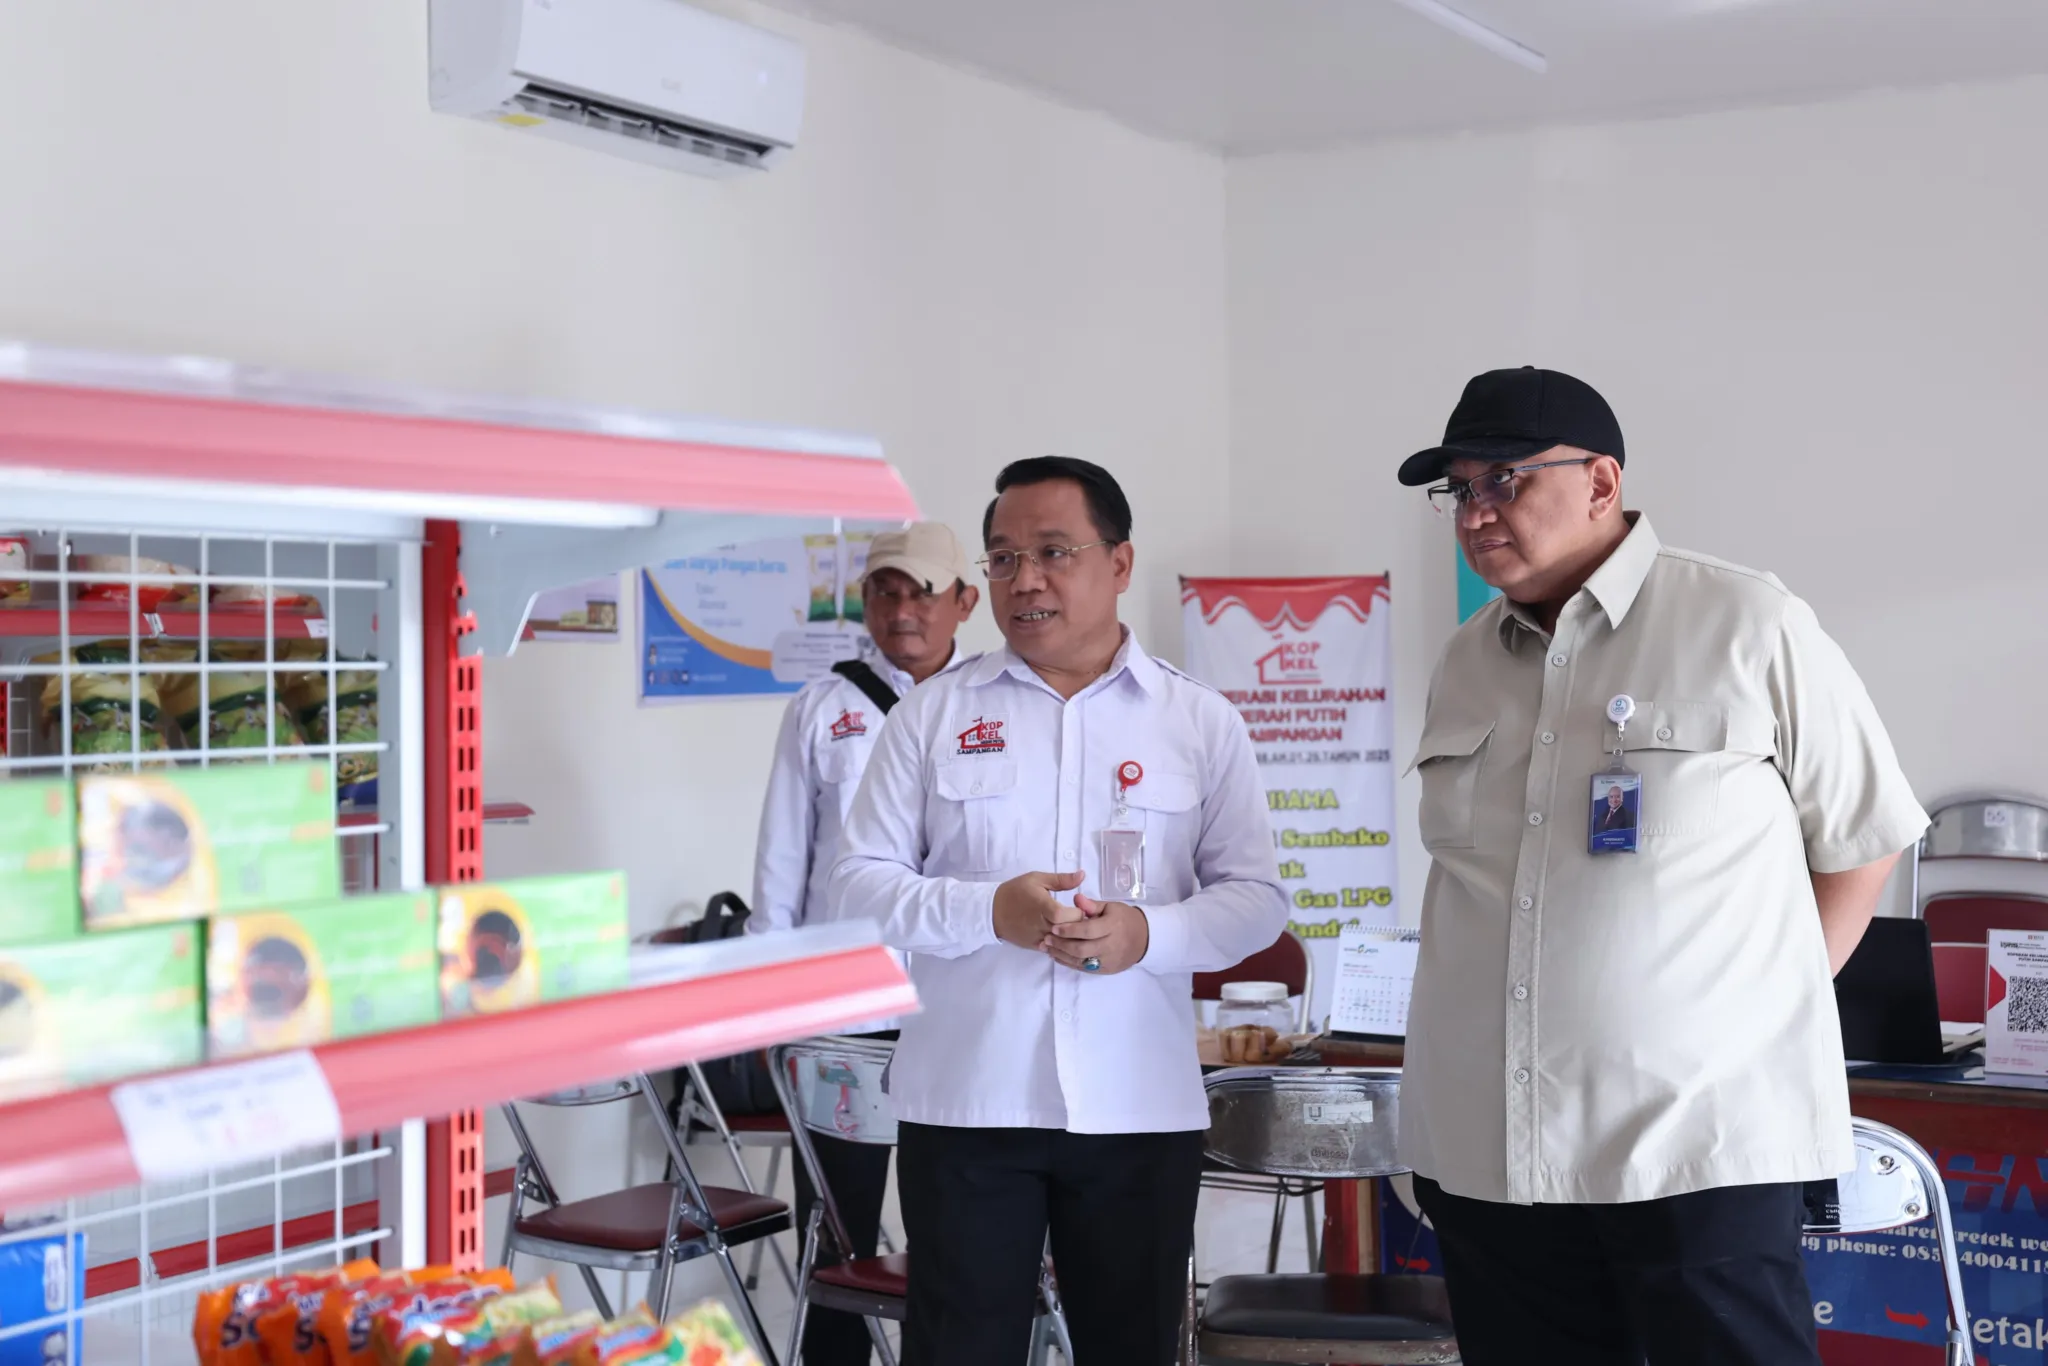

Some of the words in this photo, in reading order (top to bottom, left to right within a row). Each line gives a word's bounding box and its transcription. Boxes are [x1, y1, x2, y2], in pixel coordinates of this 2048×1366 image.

[1281, 687, 1386, 703] KELURAHAN
[1296, 708, 1347, 722] PUTIH
[981, 721, 1003, 730] KOP
[981, 730, 1002, 740] KEL
[956, 747, 1003, 755] SAMPANGAN
[1281, 827, 1390, 848] Sembako
[1294, 887, 1338, 909] Gas
[1341, 886, 1393, 907] LPG
[1826, 1236, 1896, 1257] phone:
